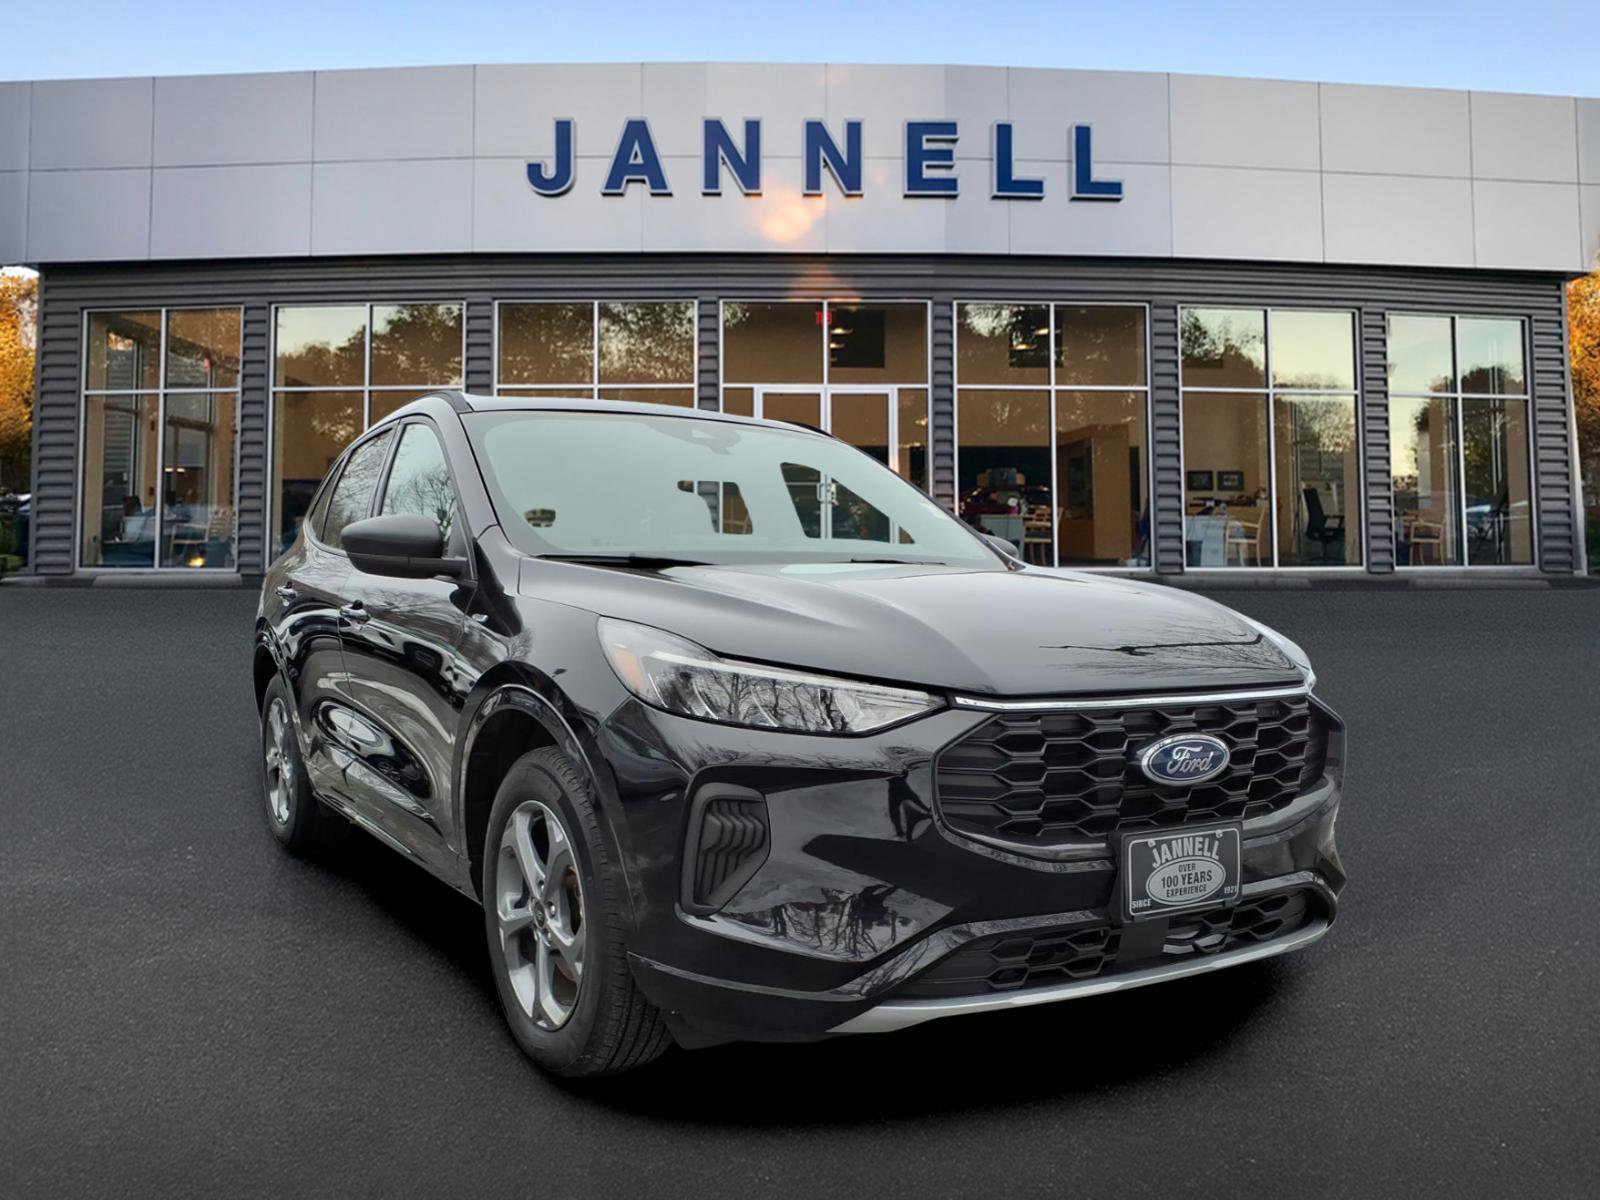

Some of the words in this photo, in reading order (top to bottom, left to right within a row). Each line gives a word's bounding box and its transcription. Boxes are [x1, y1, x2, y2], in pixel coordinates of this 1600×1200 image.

[526, 116, 1124, 199] JANNELL
[1166, 746, 1215, 774] Ford
[1151, 837, 1220, 868] JANNELL
[1178, 863, 1196, 873] OVER
[1161, 875, 1179, 889] 100
[1181, 870, 1213, 886] YEARS
[1166, 884, 1207, 897] EXPERIENCE
[1131, 899, 1152, 909] SINCE
